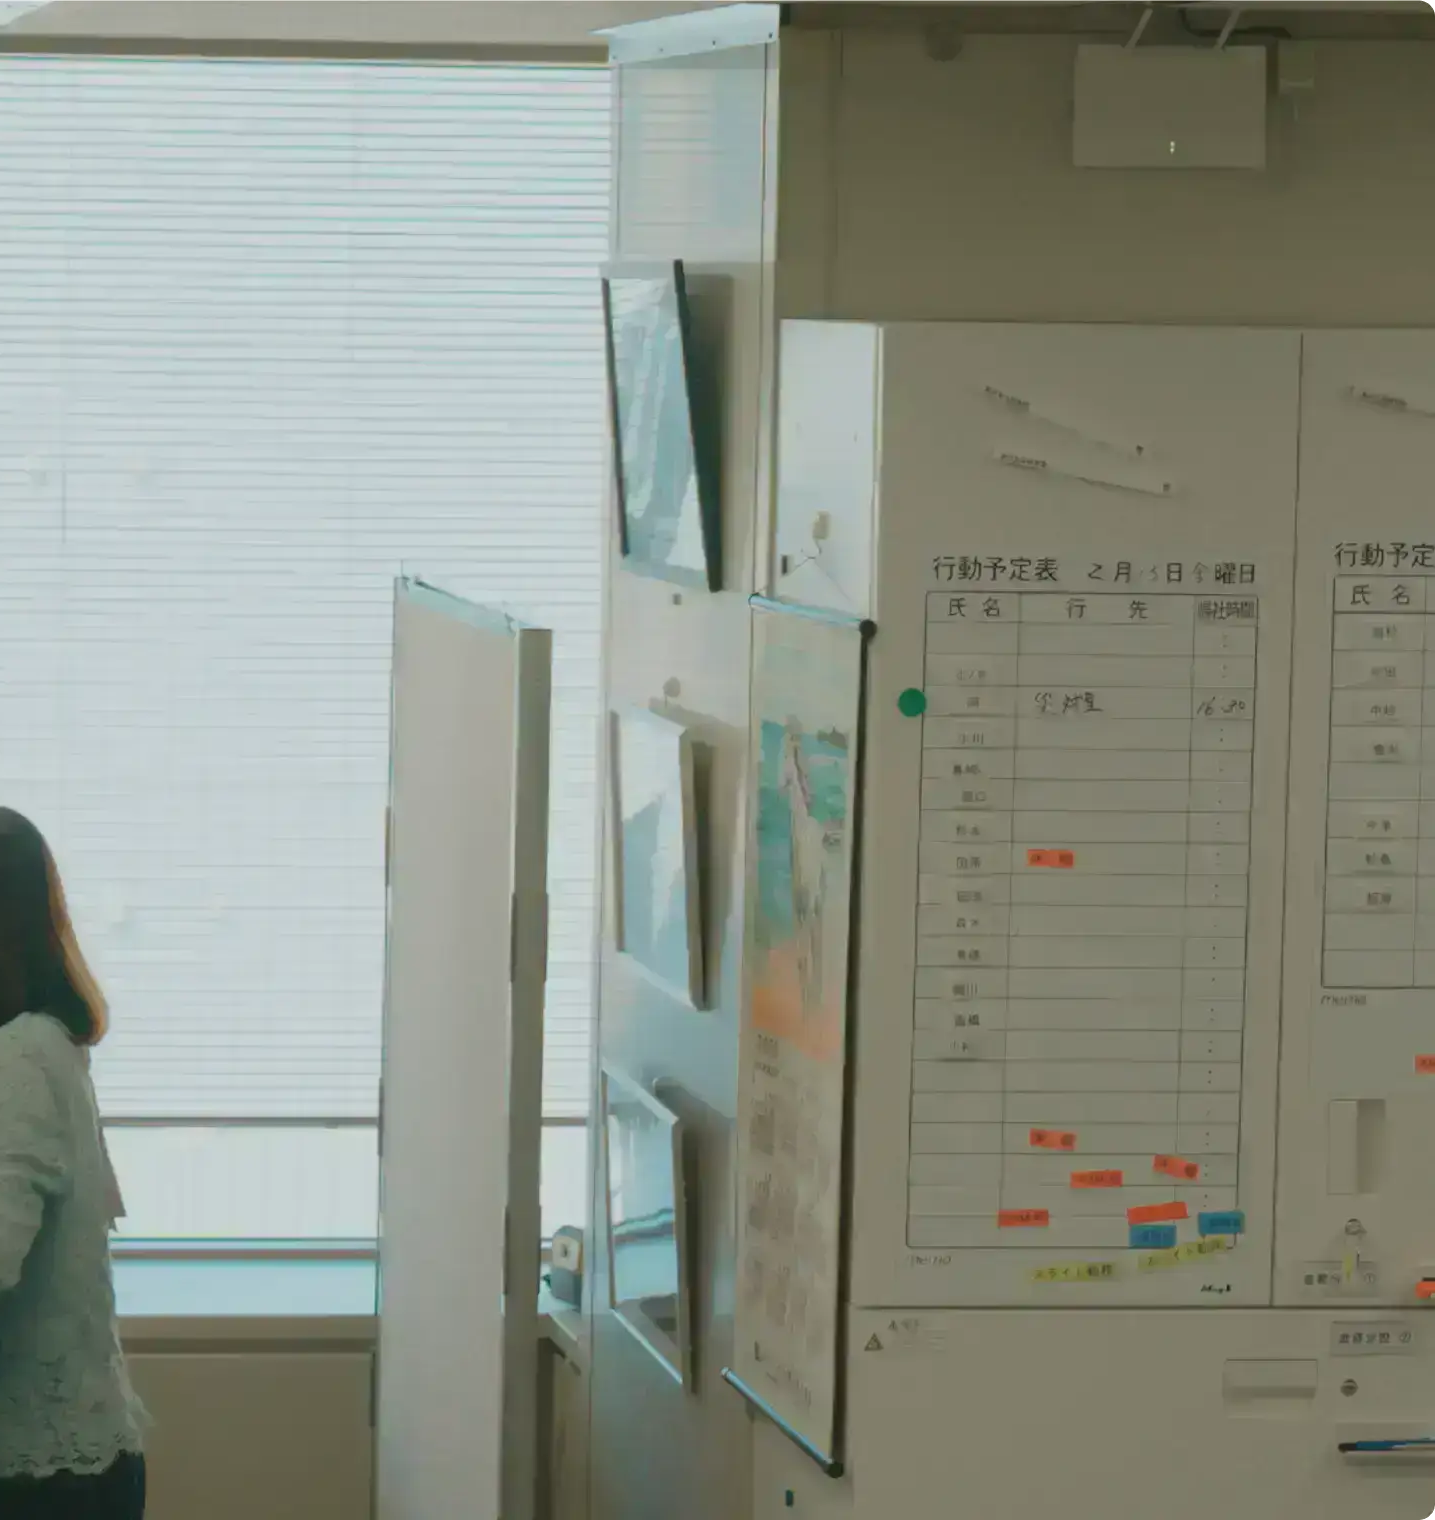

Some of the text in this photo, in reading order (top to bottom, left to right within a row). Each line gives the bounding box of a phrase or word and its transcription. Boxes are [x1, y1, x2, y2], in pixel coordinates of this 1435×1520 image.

[932, 554, 1058, 582] 行動予定表
[1350, 583, 1411, 605] 氏名
[947, 597, 1001, 617] 氏名
